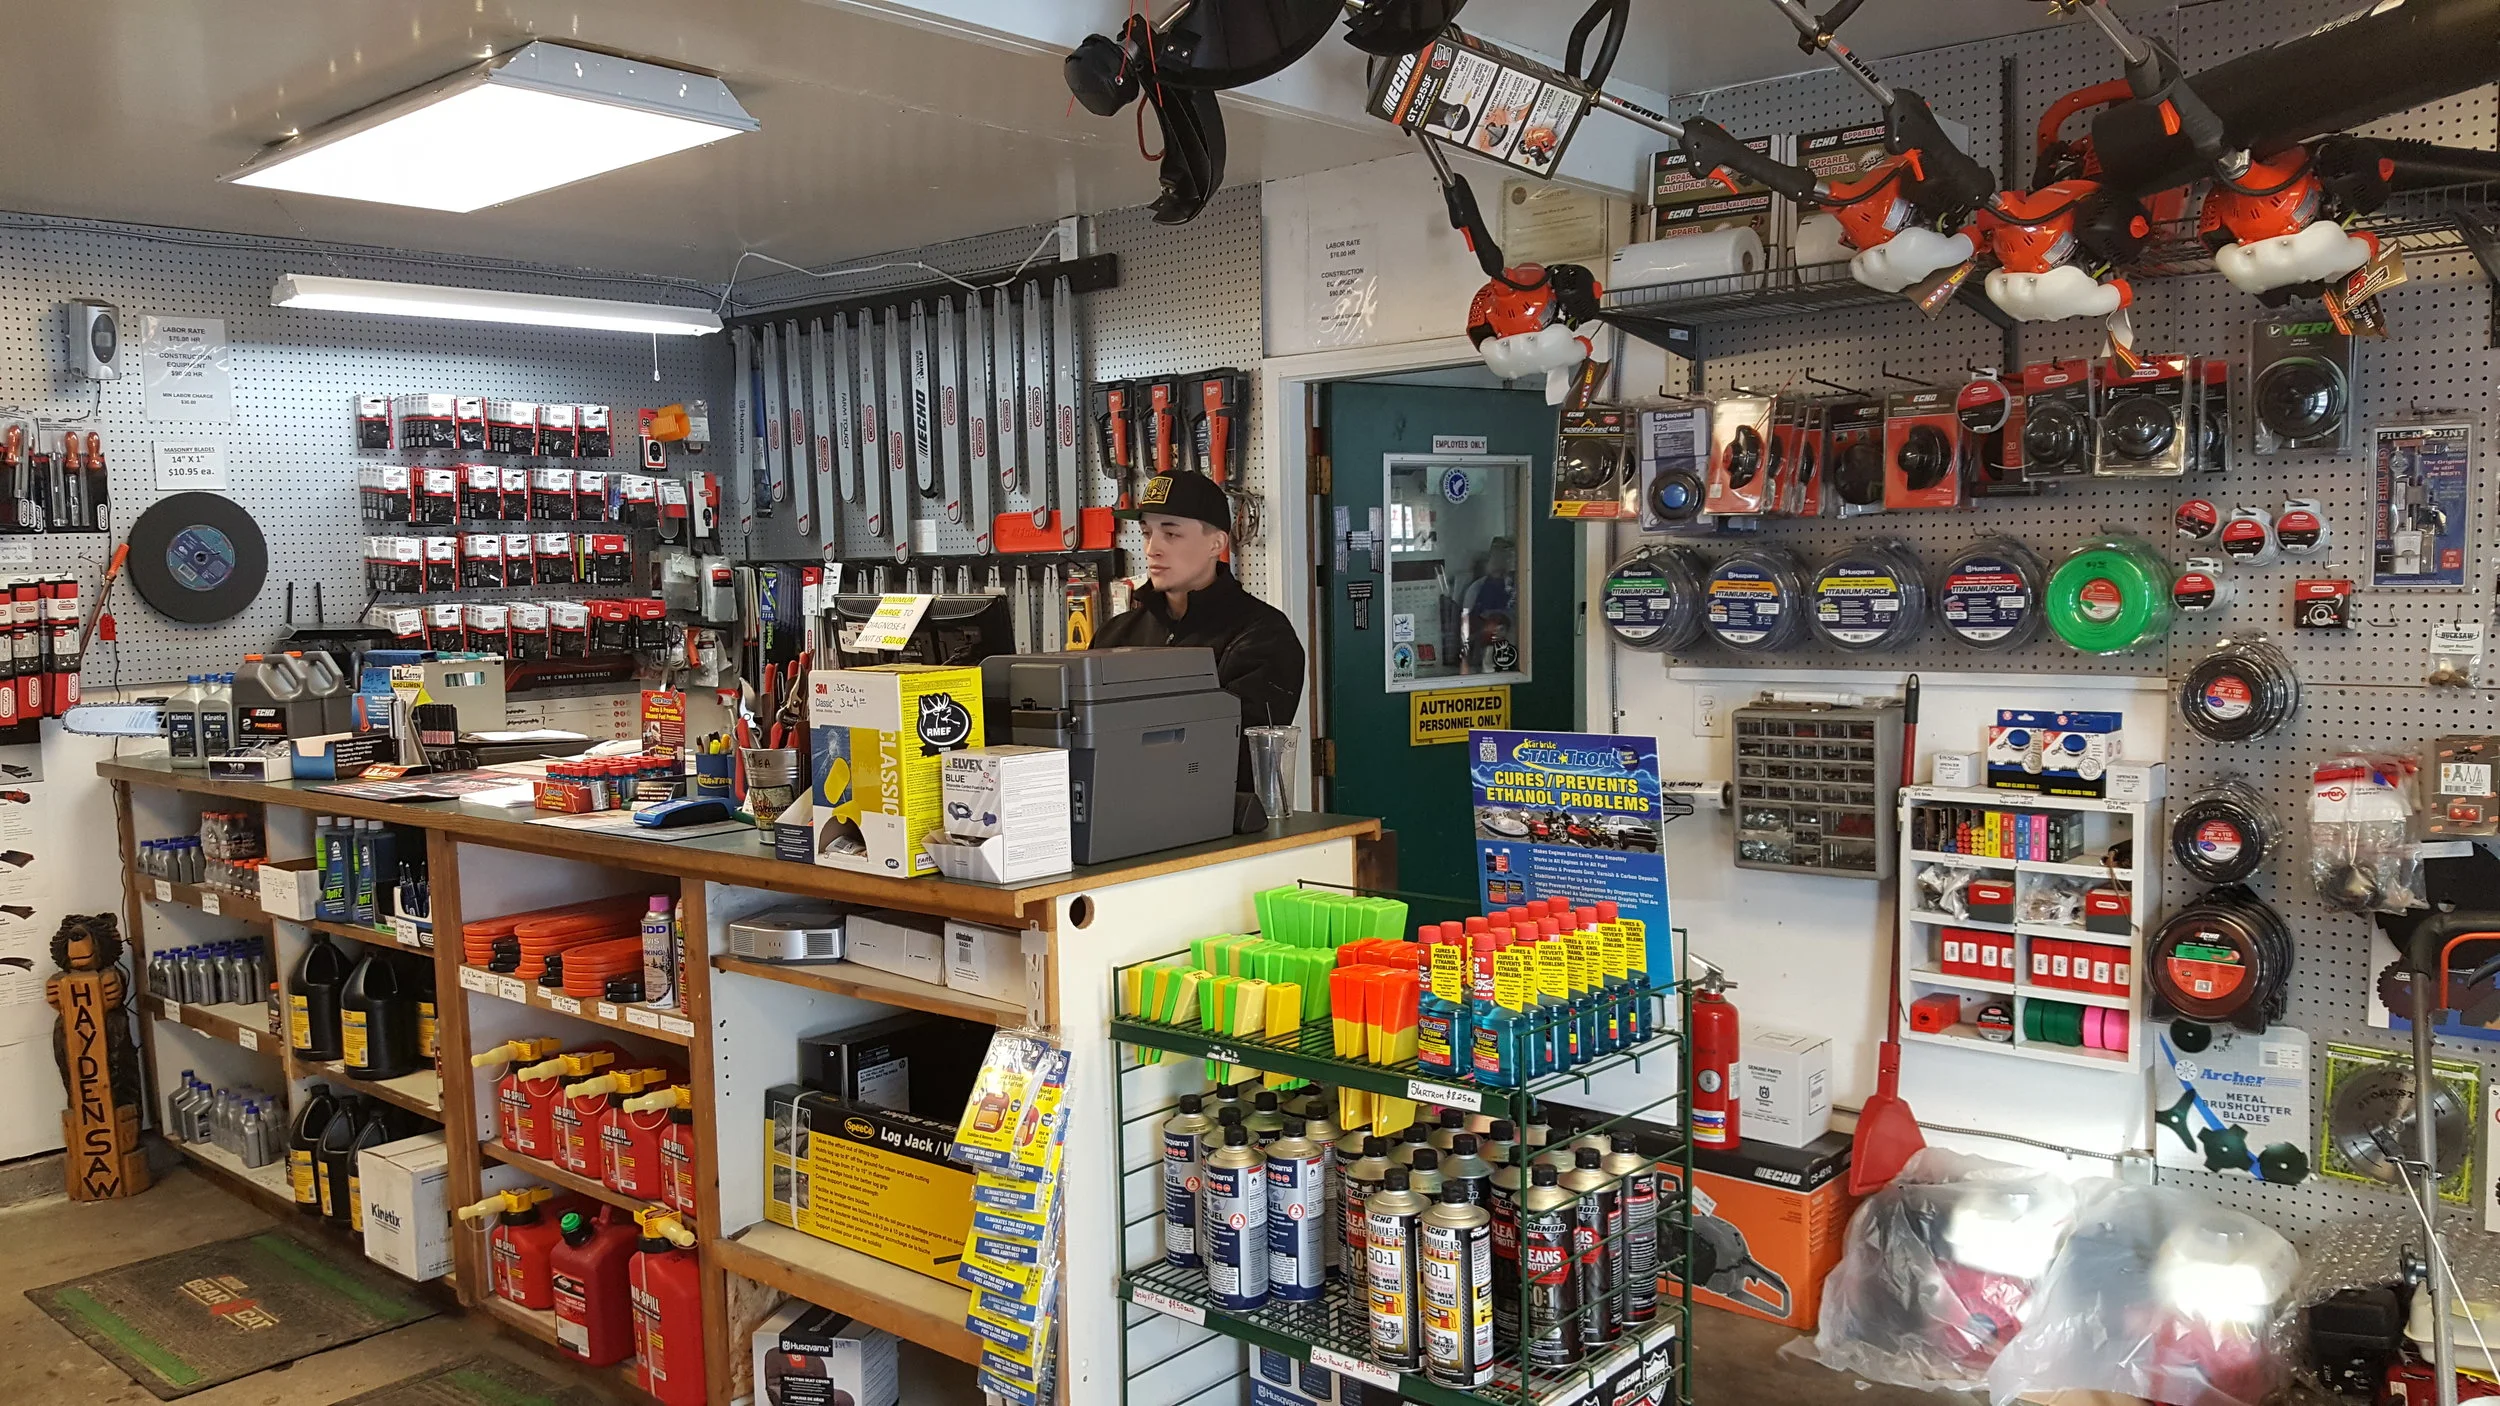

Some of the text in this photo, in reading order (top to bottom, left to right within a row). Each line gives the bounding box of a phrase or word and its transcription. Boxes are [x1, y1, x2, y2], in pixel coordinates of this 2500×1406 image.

[1382, 54, 1417, 115] ECHO
[1406, 73, 1434, 123] GT-225SF
[1808, 128, 1874, 149] ECHO APPAREL
[1808, 154, 1848, 168] APPAREL
[1831, 163, 1855, 174] PACK
[1658, 180, 1706, 194] VALUE PACK
[1666, 196, 1768, 220] ECHO APPAREL VALUE PACK
[1326, 240, 1345, 249] LABOR
[1321, 268, 1364, 278] CONSTRUCTION
[2360, 306, 2375, 329] START
[1912, 394, 1938, 403] ECHO
[916, 389, 926, 453] ECHO
[1436, 440, 1486, 448] EMPLOYEES ONLY
[168, 468, 199, 477] $10.95
[2378, 477, 2389, 500] THE
[2376, 503, 2389, 540] EDGE!
[1825, 587, 1890, 596] TITANIUM FORCE
[1951, 584, 2016, 593] TITANIUM FORCE
[867, 622, 900, 630] DIAGNOSE
[816, 684, 828, 694] 3M
[1420, 698, 1502, 715] AUTHORIZED
[171, 714, 192, 722] Kinetix
[204, 714, 225, 722] Kinetix
[1419, 716, 1502, 732] PERSONNEL ONLY
[927, 727, 951, 737] RMEF
[953, 758, 983, 771] ELVEX
[1517, 748, 1559, 764] STAR
[1568, 750, 1613, 768] TRON
[879, 730, 900, 816] CLASSIC
[946, 774, 966, 783] BLUE
[1486, 786, 1649, 812] ETHANOL PROBLEMS
[2318, 788, 2347, 800] rotary
[2201, 1068, 2265, 1084] Archer
[503, 1089, 526, 1102] NO-SPILL
[2226, 1093, 2267, 1104] METAL
[554, 1106, 577, 1120] NO-SPILL
[2202, 1100, 2292, 1116] BRUSHCUTTER
[2223, 1111, 2270, 1123] BLADES
[603, 1124, 627, 1140] NO-SPILL
[846, 1121, 872, 1135] SpeeCo
[881, 1126, 934, 1152] Log Jack
[663, 1138, 685, 1155] NO-SPILL
[830, 1167, 842, 1177] wedge
[864, 1159, 930, 1184] ground cutting
[873, 1171, 890, 1181] diameter
[1754, 1168, 1802, 1185] ECHO
[827, 1176, 879, 1197] support strength
[371, 1202, 400, 1228] Kinetix
[985, 1216, 1008, 1226] ELIMINATES
[1016, 1222, 1026, 1230] NEED
[1002, 1225, 1024, 1235] ADDITIVES!
[1426, 1226, 1448, 1237] ECHO
[495, 1238, 516, 1252] NO-SPILL
[1368, 1246, 1396, 1266] 50:1
[967, 1266, 988, 1279] ELIMINATES
[1424, 1259, 1451, 1280] 50:1
[185, 1278, 231, 1305] BEAR
[631, 1284, 660, 1313] NO-SPILL
[234, 1309, 274, 1330] CAT
[790, 1342, 829, 1353] Husqvarna
